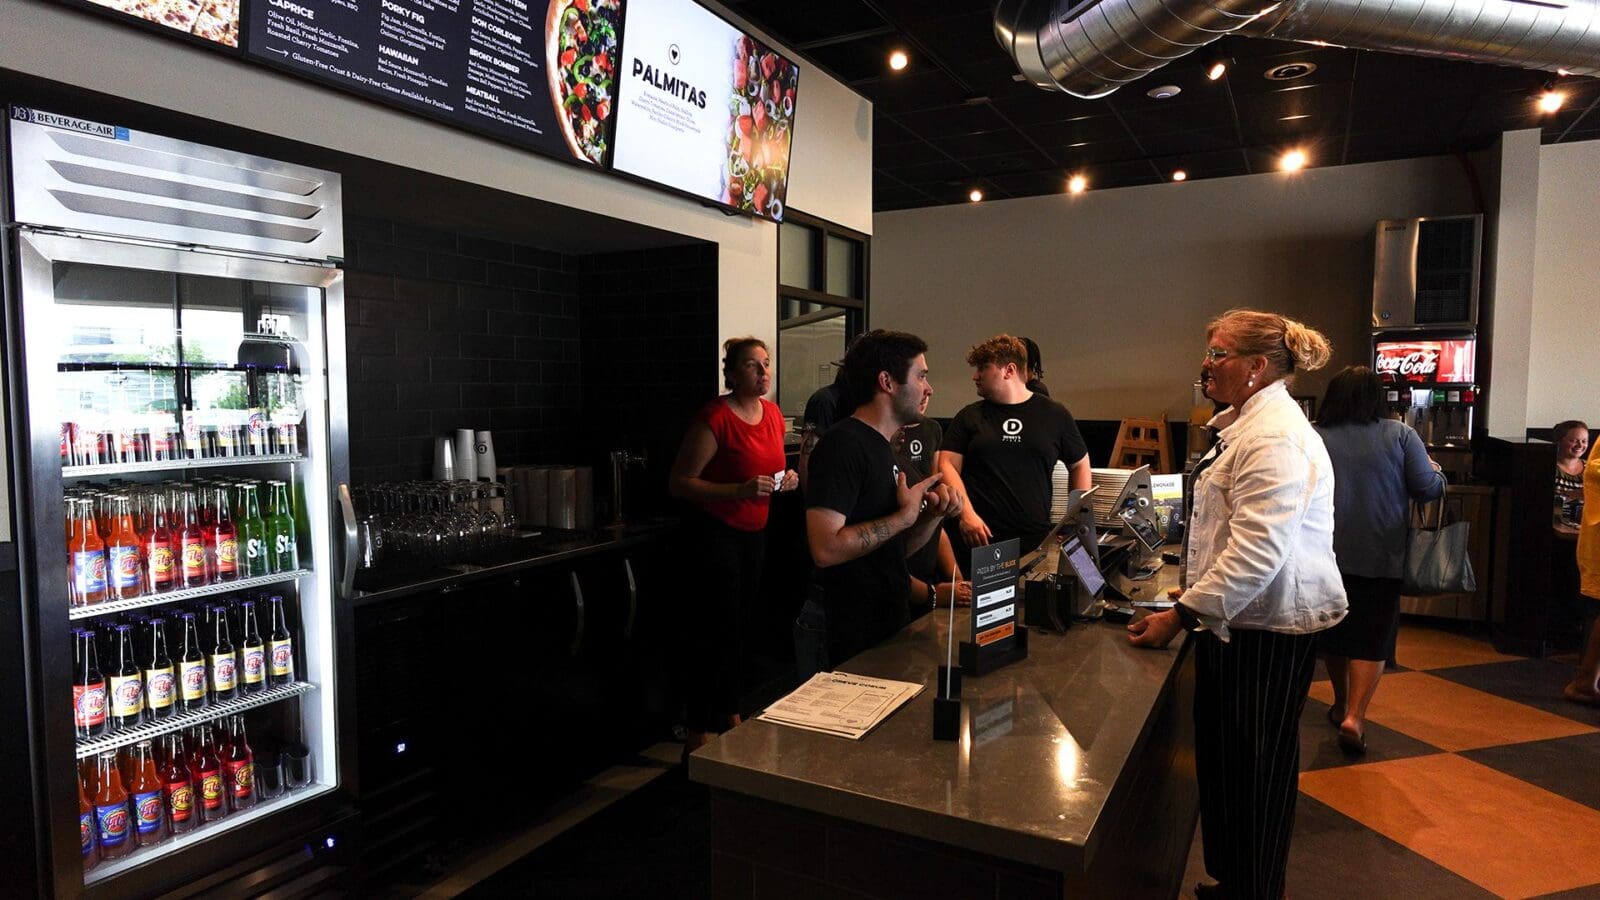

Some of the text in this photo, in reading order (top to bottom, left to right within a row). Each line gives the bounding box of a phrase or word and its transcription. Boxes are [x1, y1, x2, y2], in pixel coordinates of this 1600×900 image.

[268, 0, 314, 19] CAPRICE
[268, 10, 284, 21] Olive
[382, 0, 424, 24] PORKY FIG
[472, 16, 522, 44] DON CORLEONE
[292, 52, 328, 70] Gluten-Free
[379, 44, 419, 66] HAWAIIAN
[469, 47, 493, 64] BRONX
[632, 57, 706, 109] PALMITAS
[466, 85, 500, 104] MEATBALL
[37, 113, 113, 136] BEVERAGE-AIR
[1005, 420, 1021, 433] D
